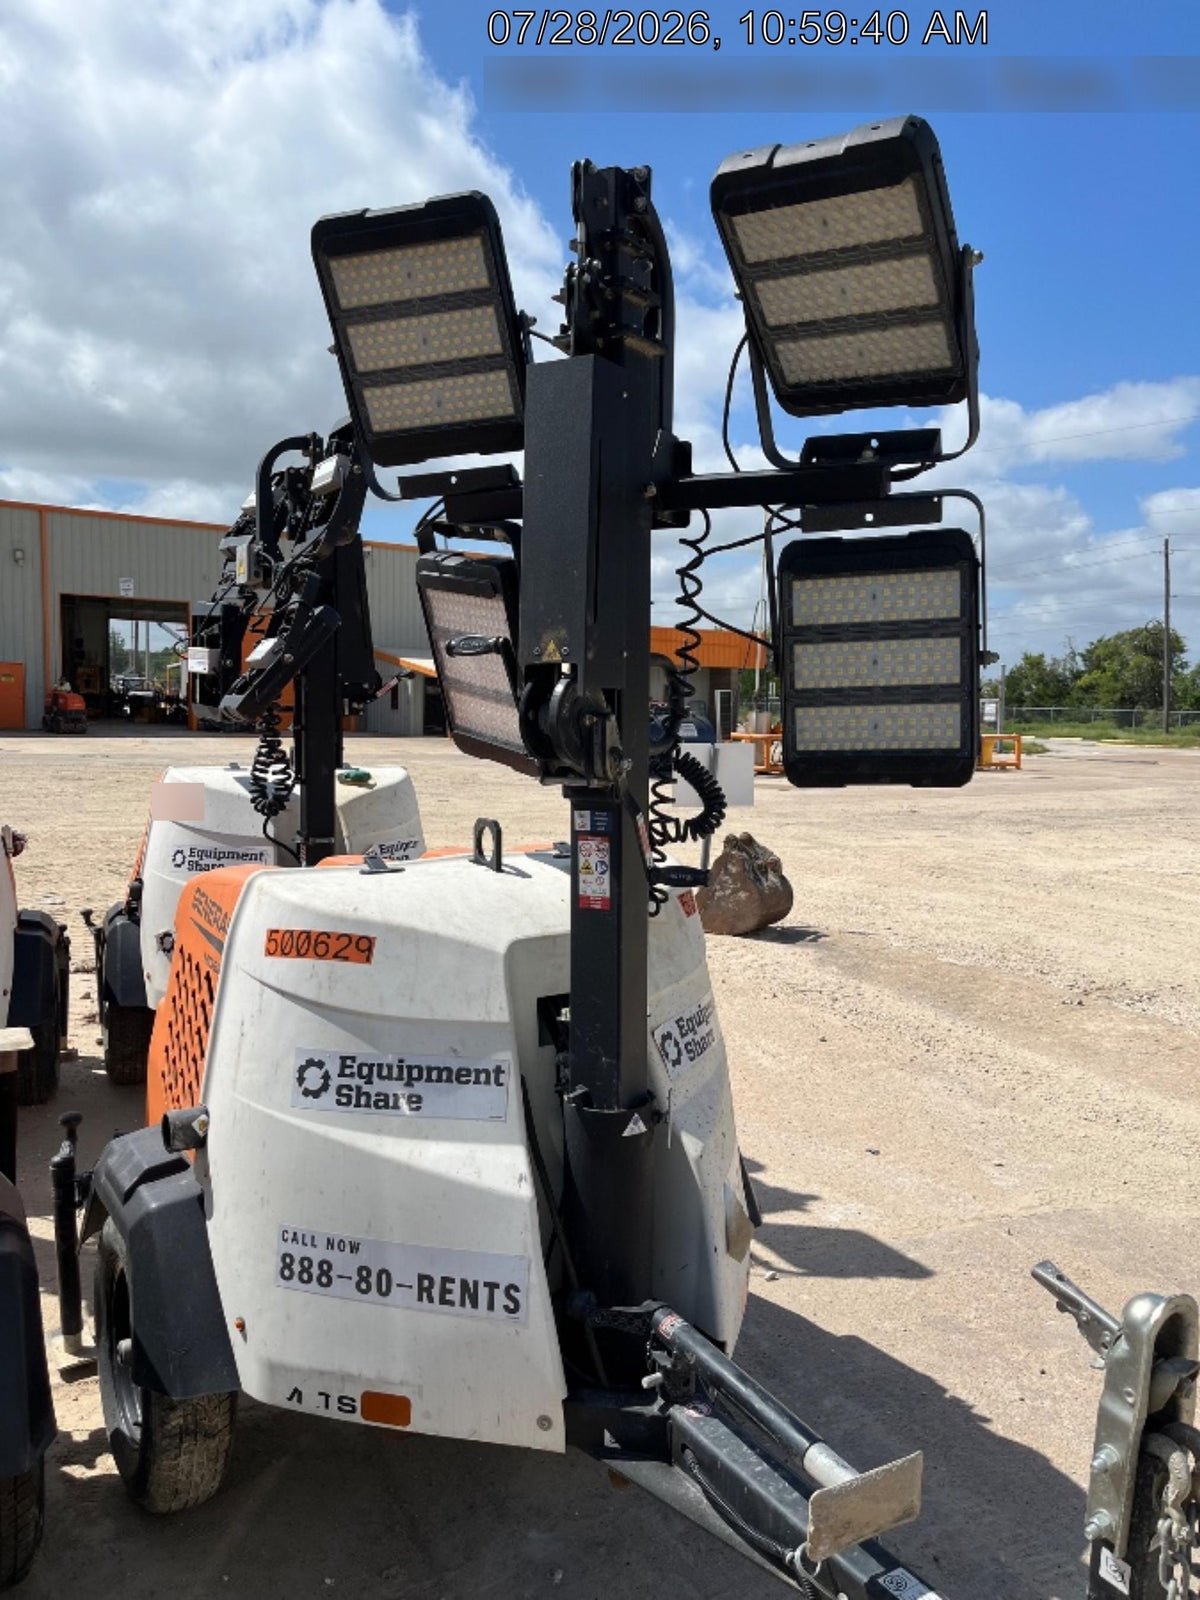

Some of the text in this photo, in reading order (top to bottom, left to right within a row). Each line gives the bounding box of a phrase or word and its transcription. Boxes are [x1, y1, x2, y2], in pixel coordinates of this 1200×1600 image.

[188, 848, 264, 861] Equipment
[266, 929, 373, 963] 500629
[337, 1055, 505, 1087] Equipment
[335, 1084, 423, 1112] Share
[281, 1229, 362, 1255] CALL NOW
[279, 1252, 521, 1315] 888-80-RENTS
